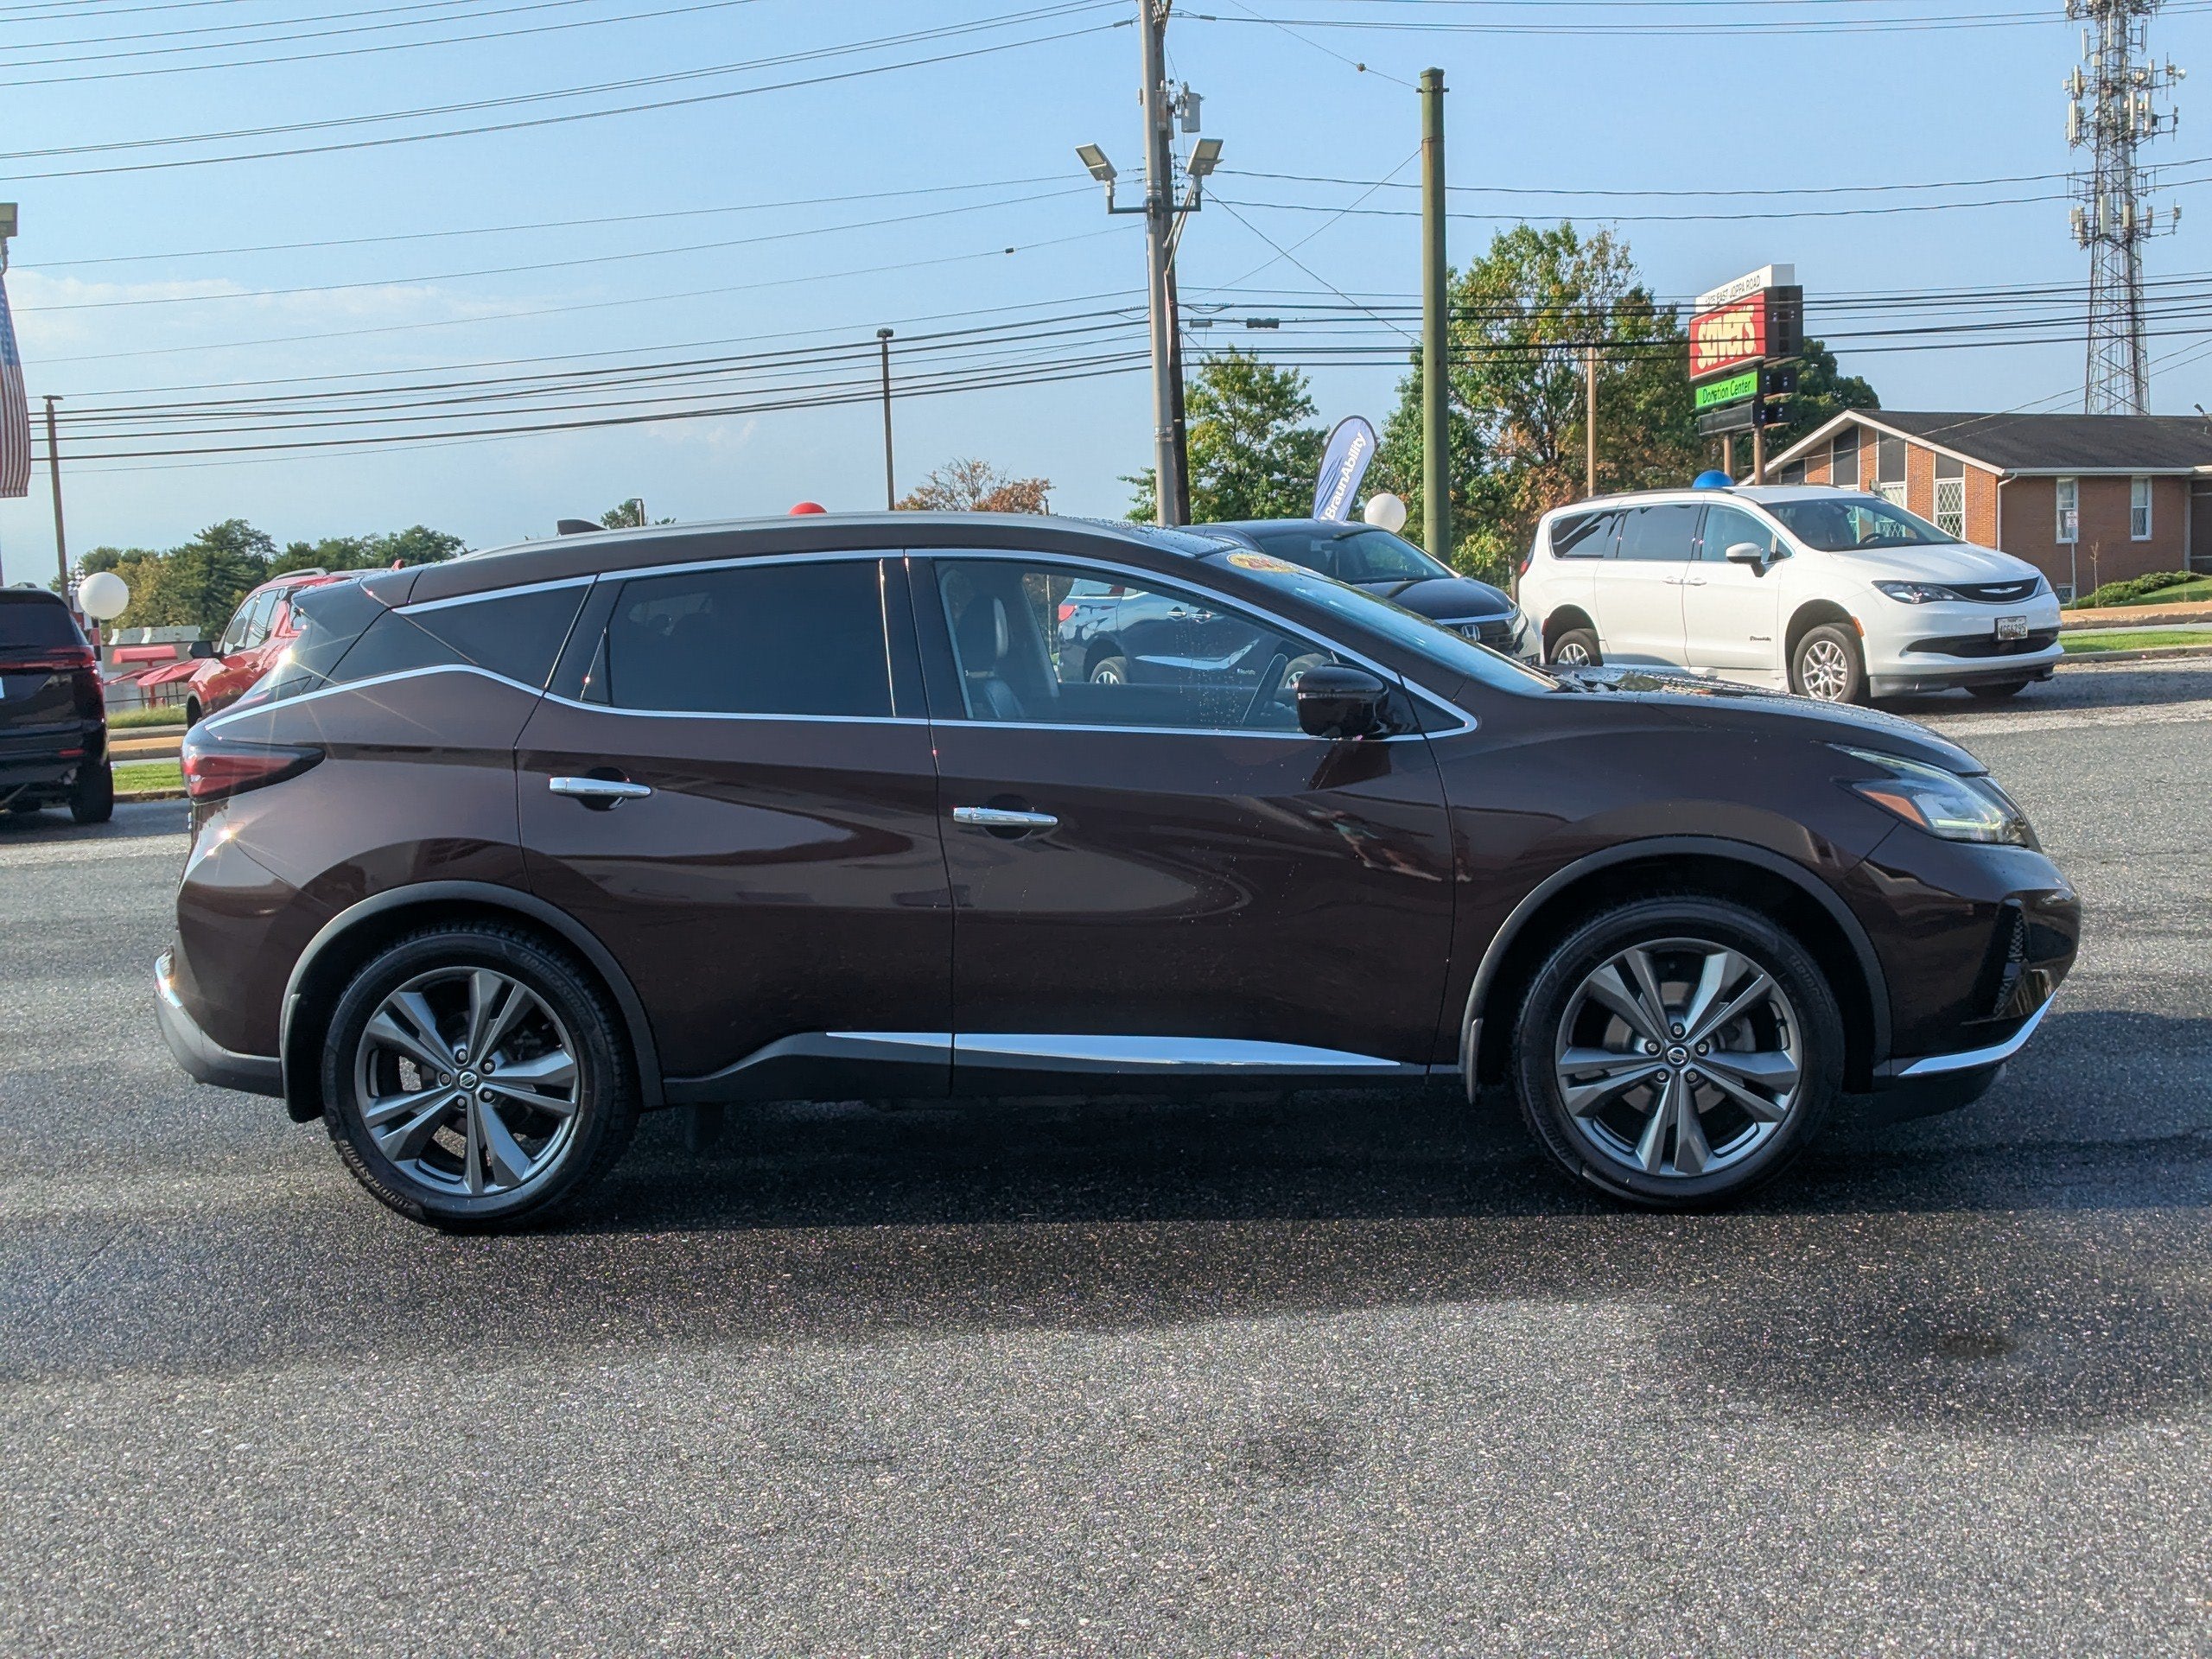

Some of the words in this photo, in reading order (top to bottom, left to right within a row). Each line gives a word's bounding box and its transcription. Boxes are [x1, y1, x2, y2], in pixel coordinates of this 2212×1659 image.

[1746, 276, 1760, 291] ROAD
[1702, 384, 1729, 404] Donation
[1730, 380, 1751, 397] Center
[1325, 432, 1366, 520] BraunAbility
